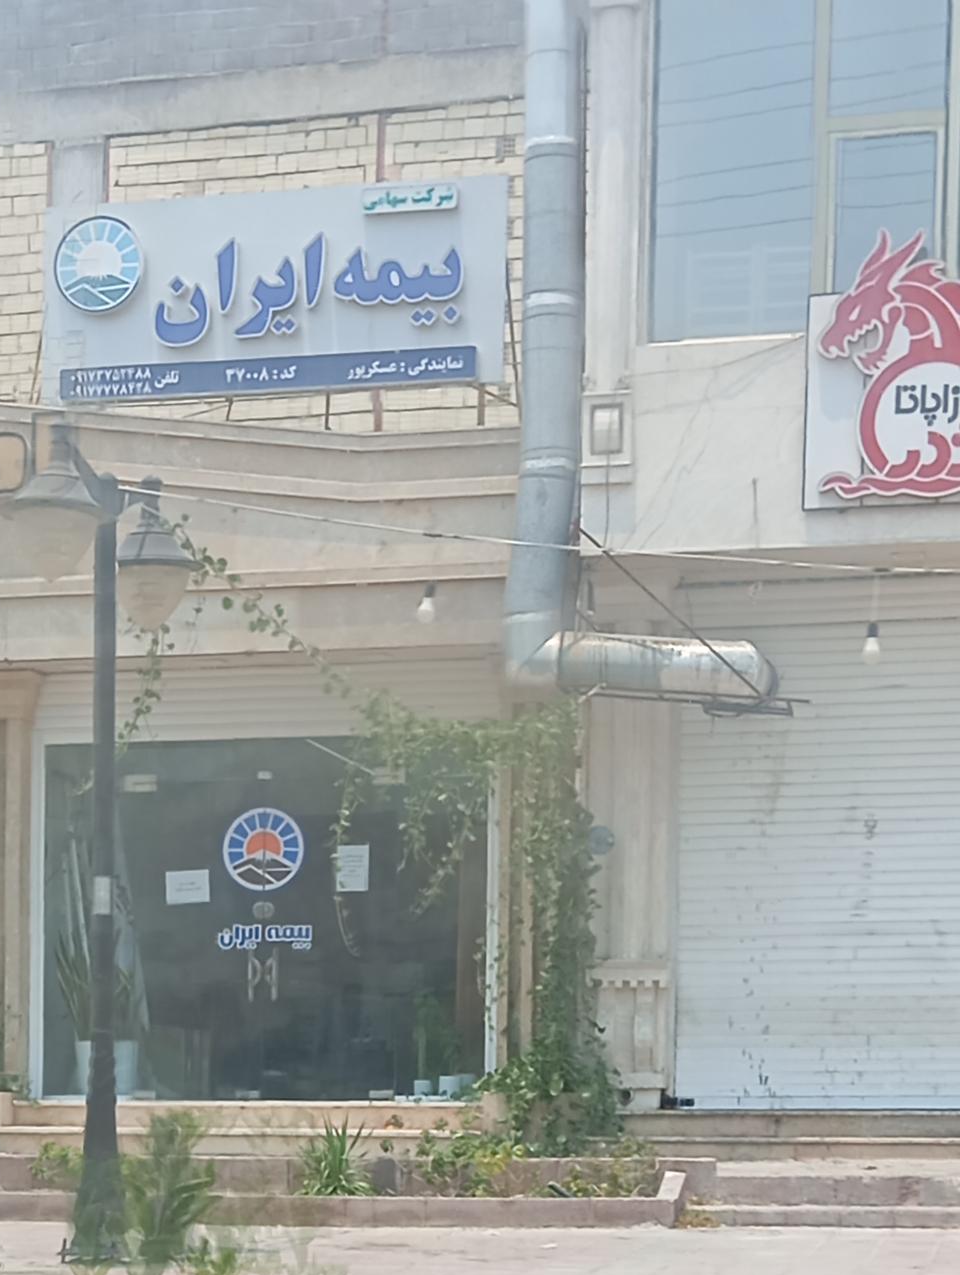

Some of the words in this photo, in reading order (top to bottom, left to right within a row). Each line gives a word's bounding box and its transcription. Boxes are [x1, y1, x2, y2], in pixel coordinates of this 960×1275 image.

[363, 190, 408, 211] سهامی
[410, 186, 454, 207] شرکت
[154, 230, 326, 348] ایران
[334, 244, 464, 326] بیمه
[154, 370, 180, 389] تلفن
[225, 366, 269, 383] ۳۷۰۰۸
[895, 383, 960, 427] زاپاتا
[218, 924, 262, 950] ایران
[265, 925, 312, 950] بیمه
